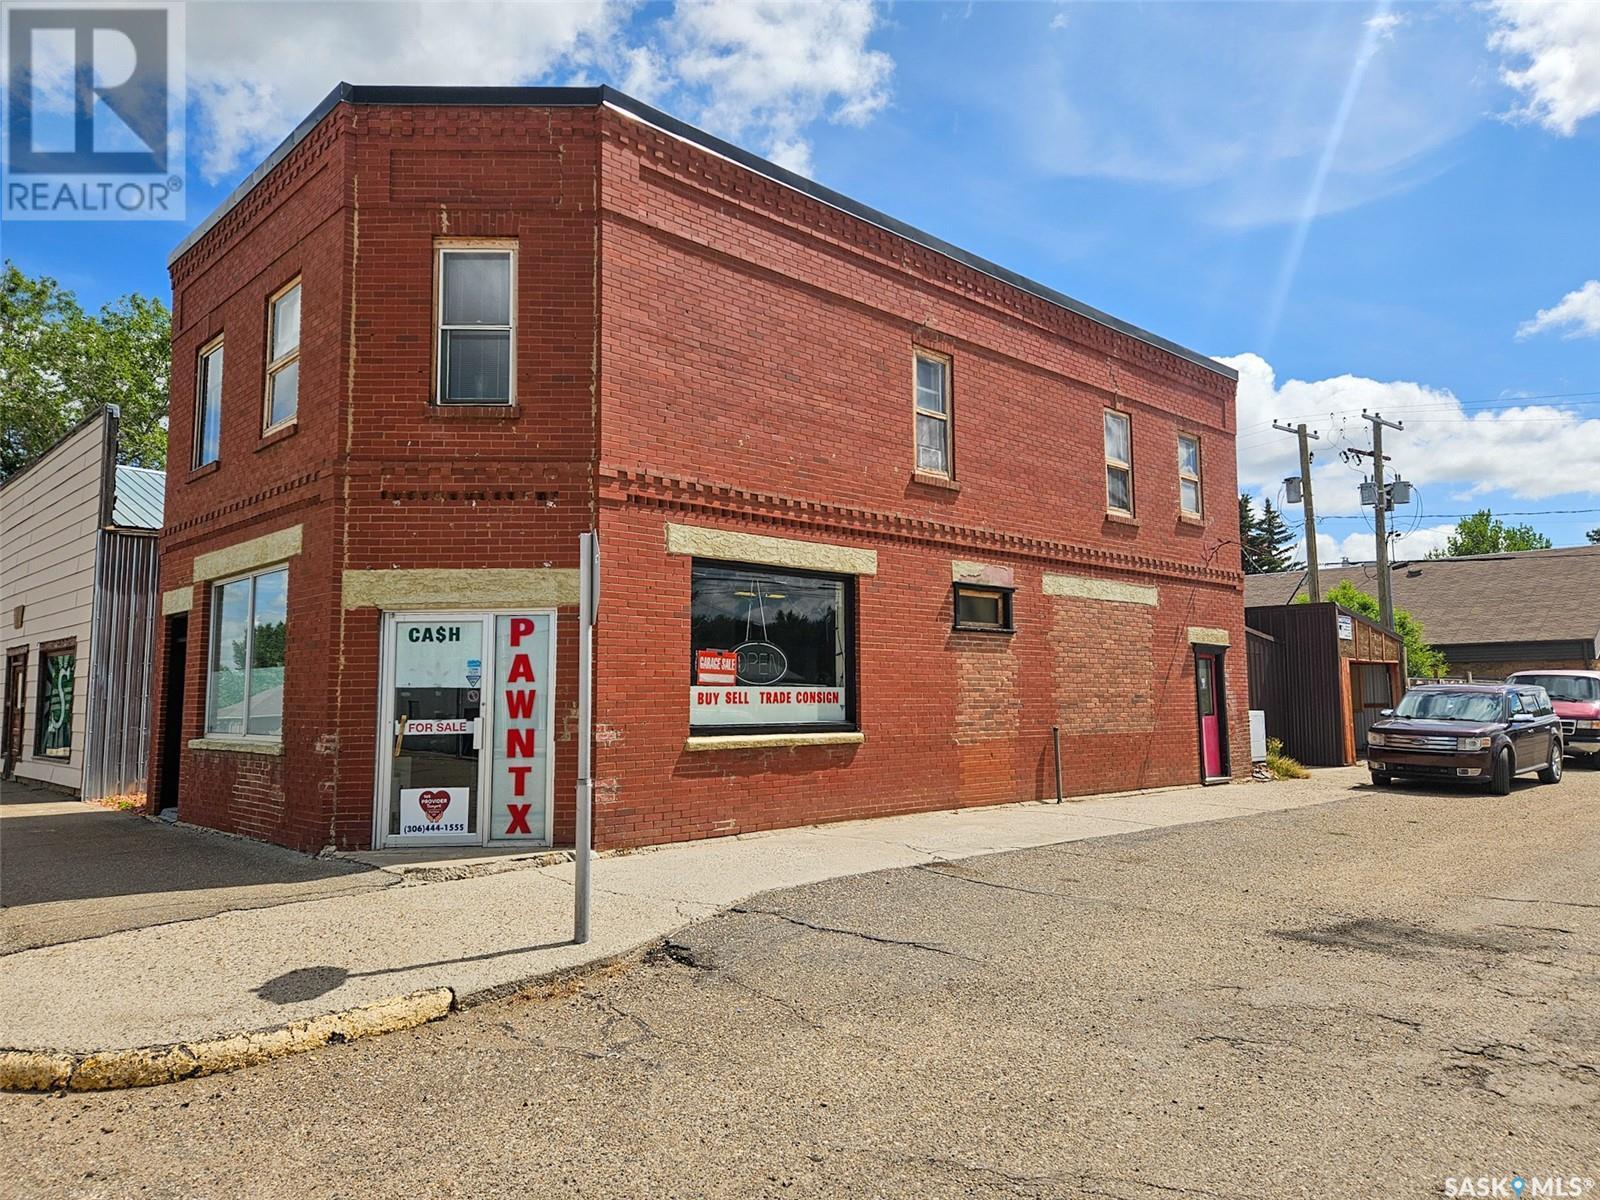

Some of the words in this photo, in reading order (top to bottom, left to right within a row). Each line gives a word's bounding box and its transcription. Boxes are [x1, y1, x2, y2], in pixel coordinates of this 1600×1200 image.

[408, 625, 461, 643] CA$H
[700, 656, 720, 670] GARAGE
[721, 658, 736, 671] SALE
[697, 692, 720, 705] BUY
[725, 691, 749, 704] SELL
[759, 691, 792, 704] TRADE
[796, 691, 839, 704] CONSIGN
[408, 723, 433, 733] FOR
[436, 722, 467, 732] SALE
[404, 824, 464, 834] (306)444-1555
